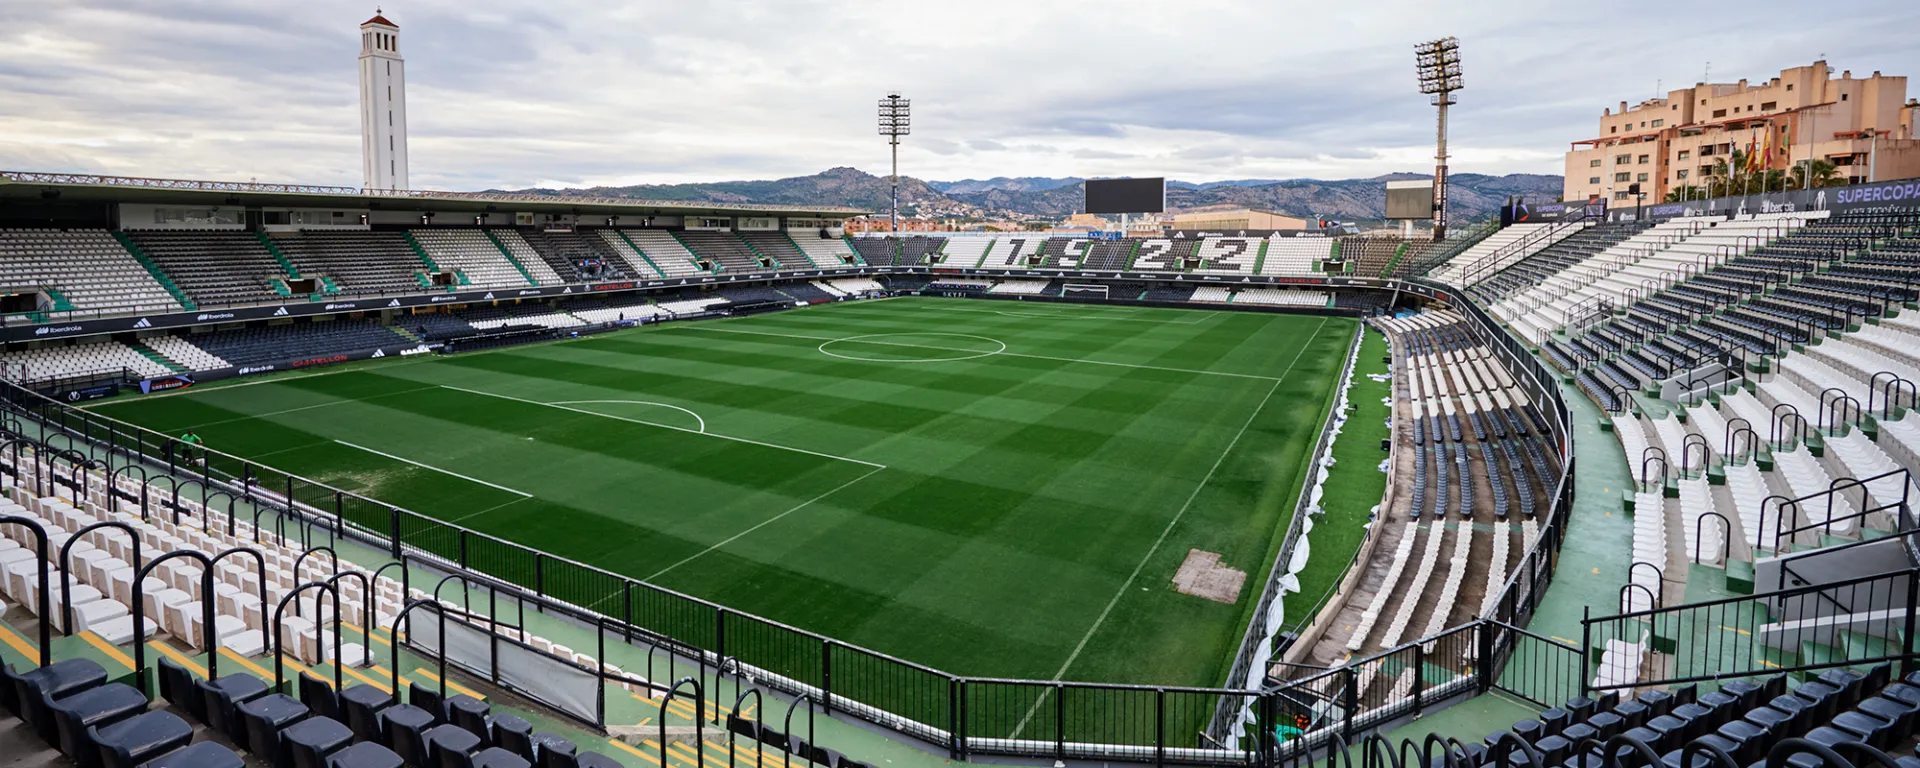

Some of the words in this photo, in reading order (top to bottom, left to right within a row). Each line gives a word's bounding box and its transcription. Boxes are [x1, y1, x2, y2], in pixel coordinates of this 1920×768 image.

[1536, 204, 1565, 213] SUPERCOPA
[1653, 205, 1682, 216] SUPERCOPA
[50, 325, 82, 334] Iberdrola
